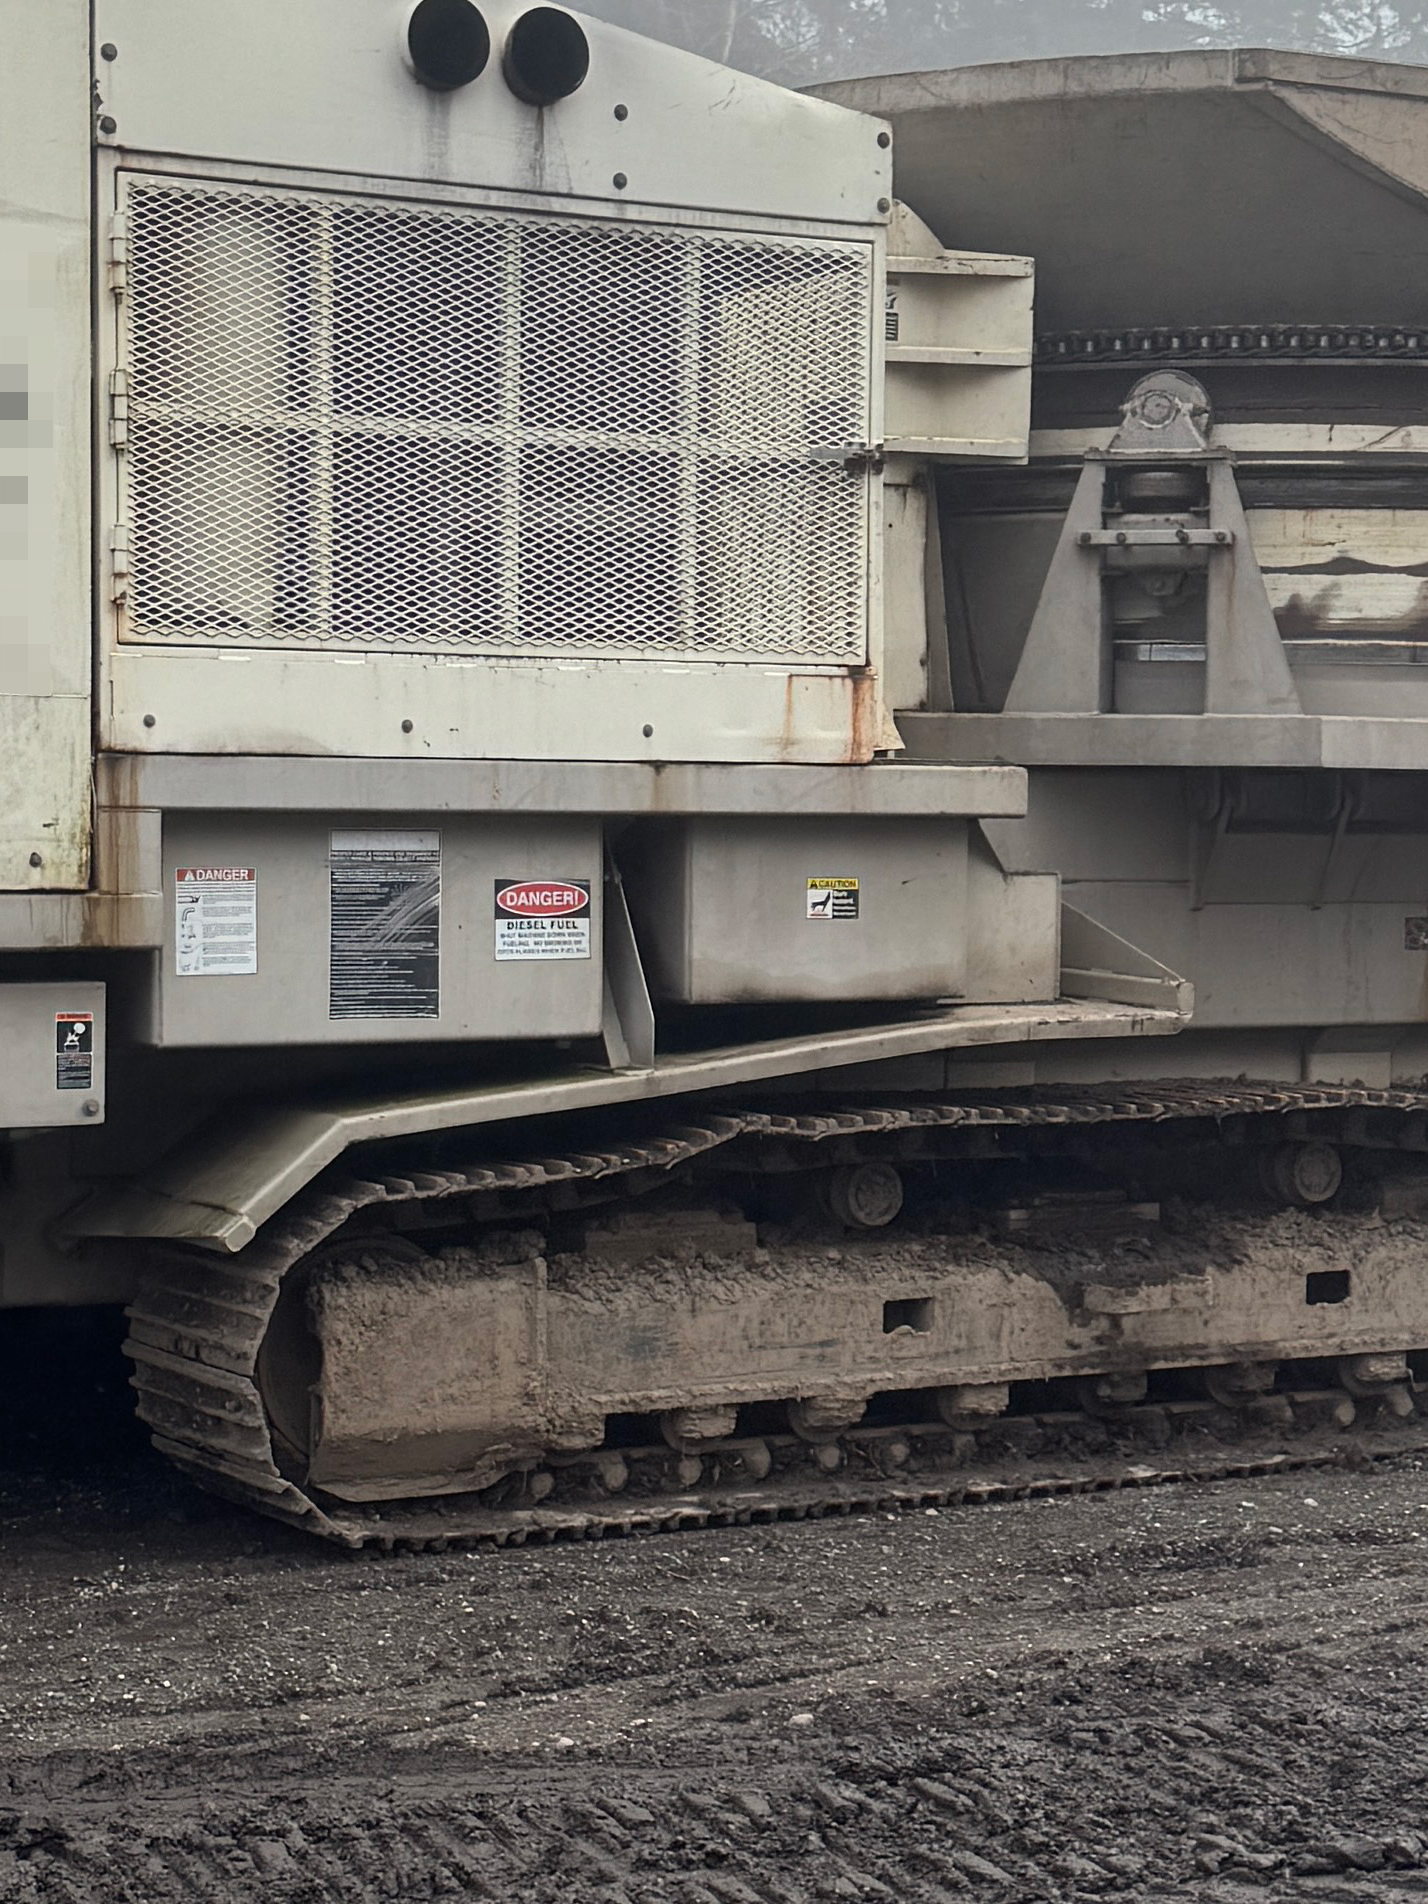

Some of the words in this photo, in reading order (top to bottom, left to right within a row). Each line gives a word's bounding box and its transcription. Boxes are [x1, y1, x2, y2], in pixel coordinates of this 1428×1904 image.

[196, 869, 249, 881] DANGER
[819, 879, 856, 888] CAUTION
[506, 920, 547, 930] DIESEL
[550, 919, 579, 930] FUEL
